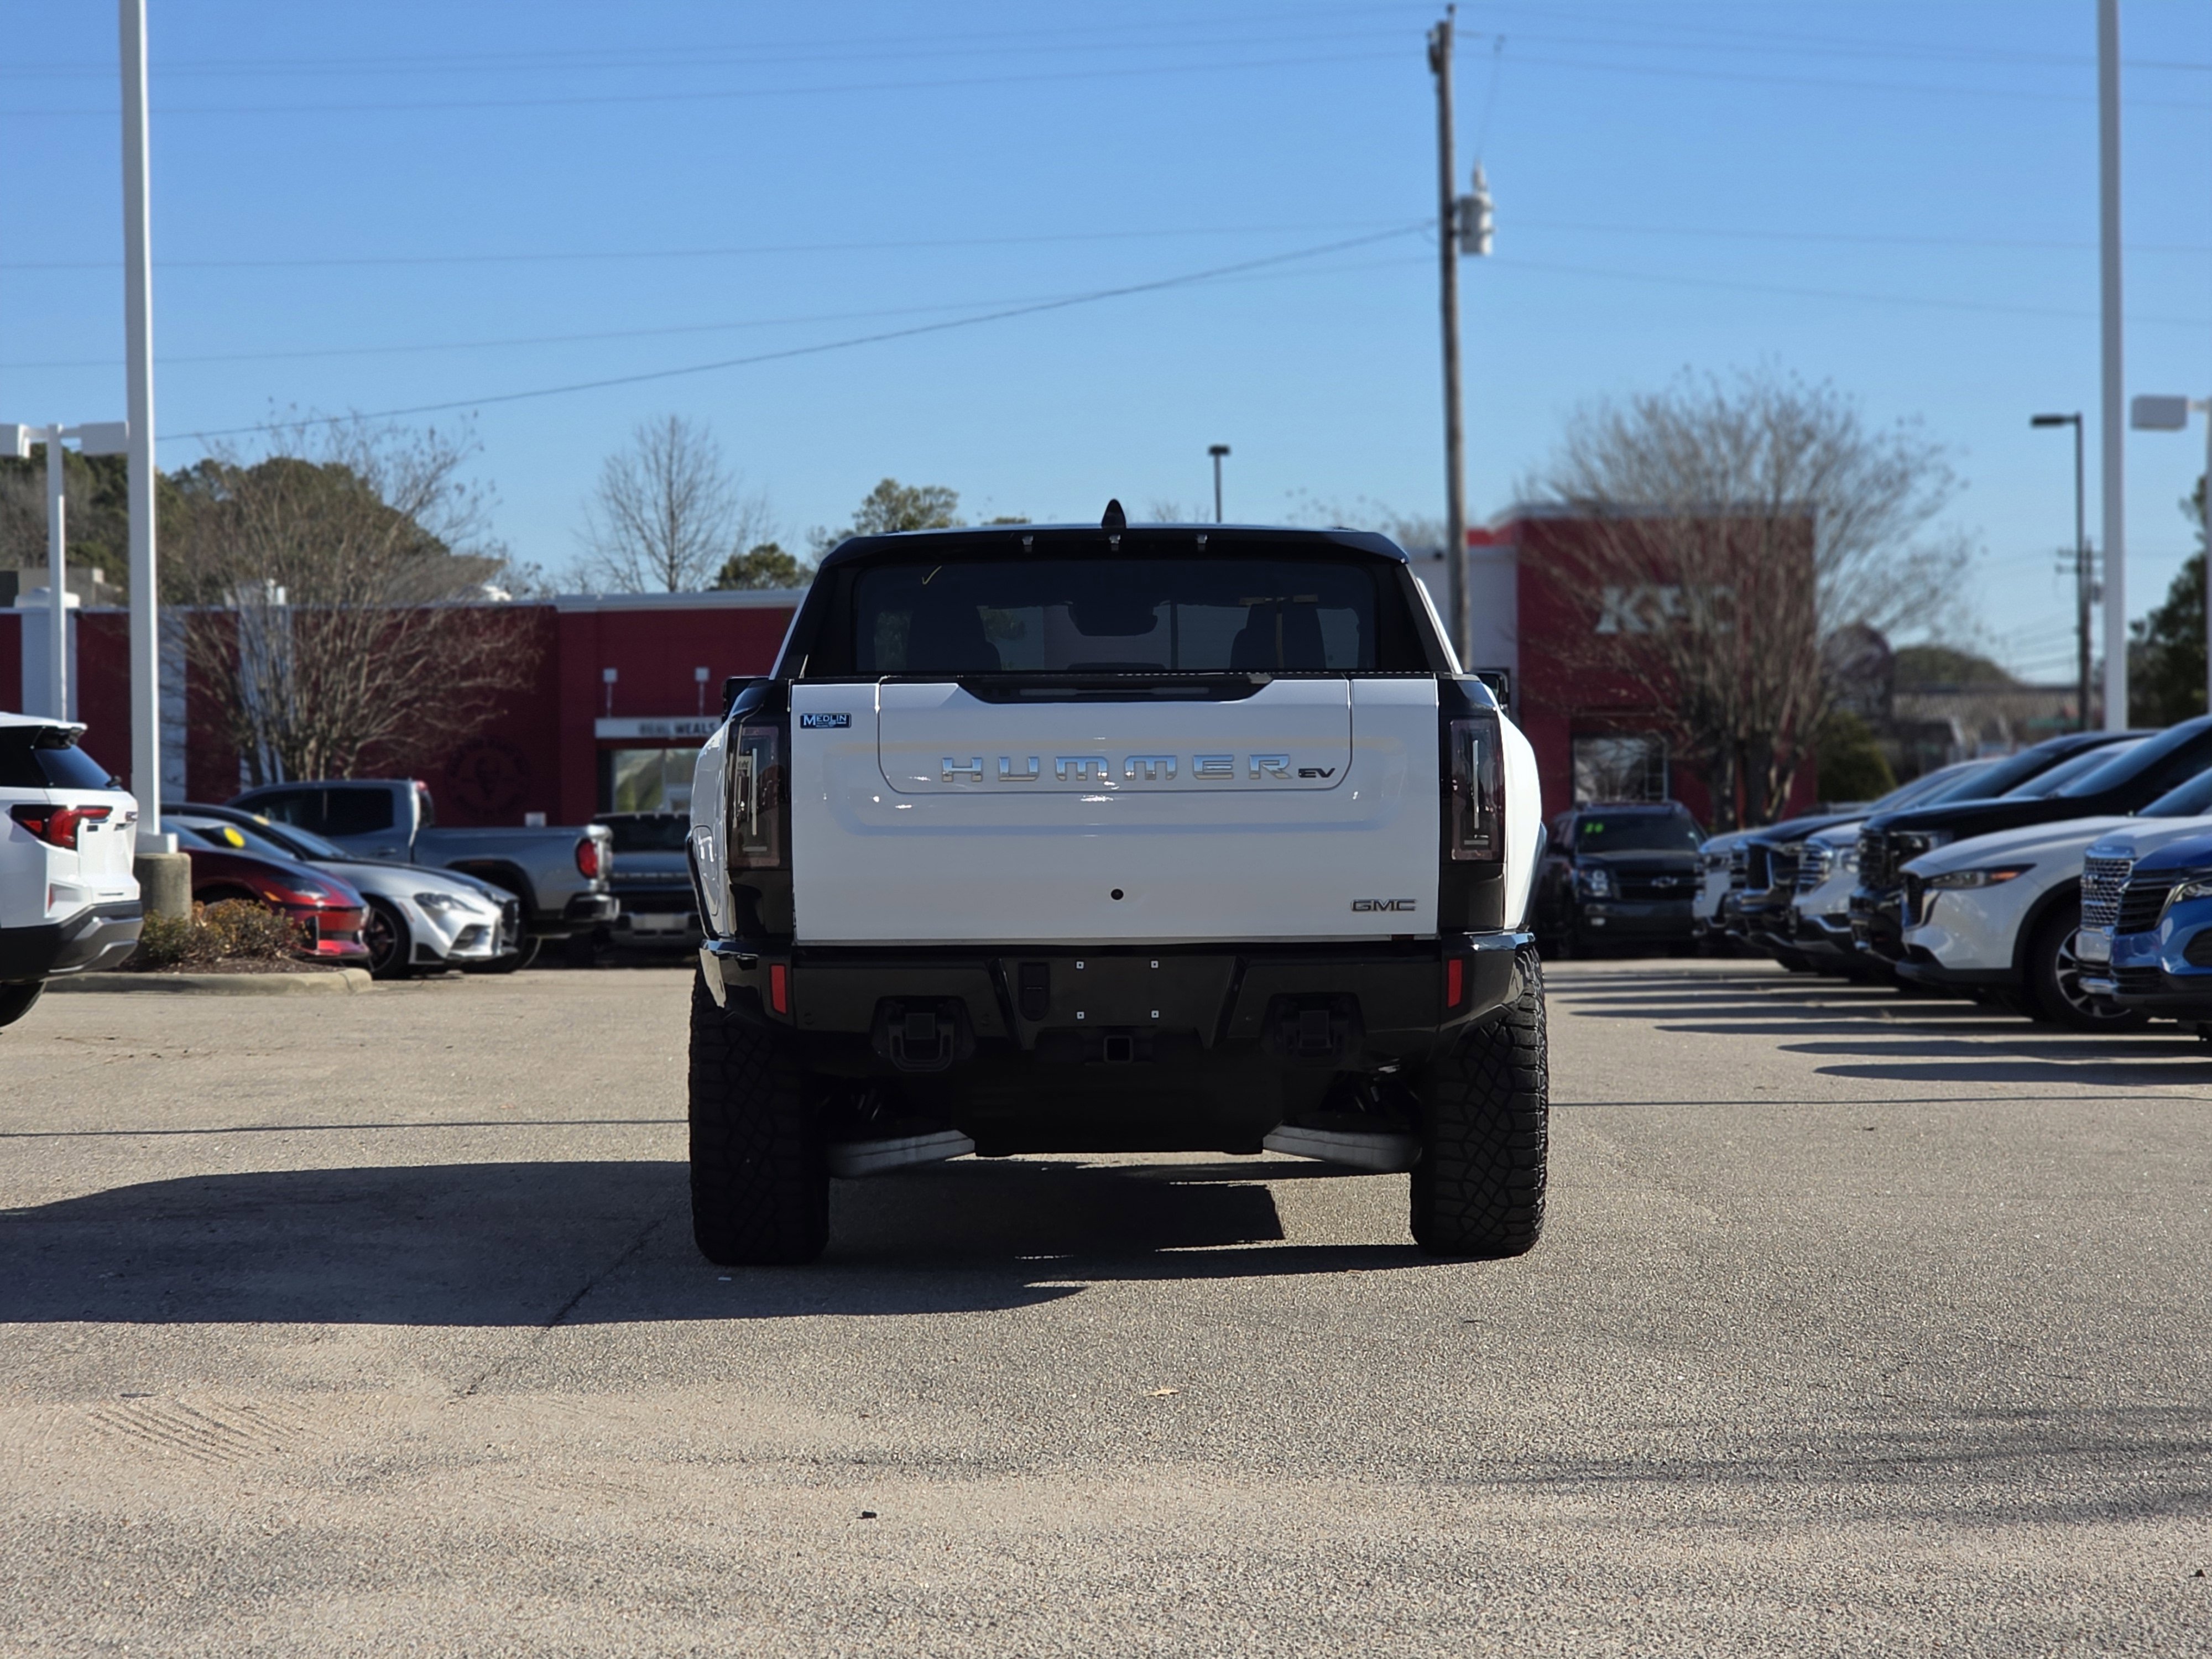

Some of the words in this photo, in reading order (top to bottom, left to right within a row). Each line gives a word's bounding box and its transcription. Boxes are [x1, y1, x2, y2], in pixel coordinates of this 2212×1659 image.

[803, 714, 847, 726] MEDLIN
[942, 754, 1293, 782] HUMMER
[1298, 768, 1335, 778] EV
[1350, 899, 1416, 911] GMC
